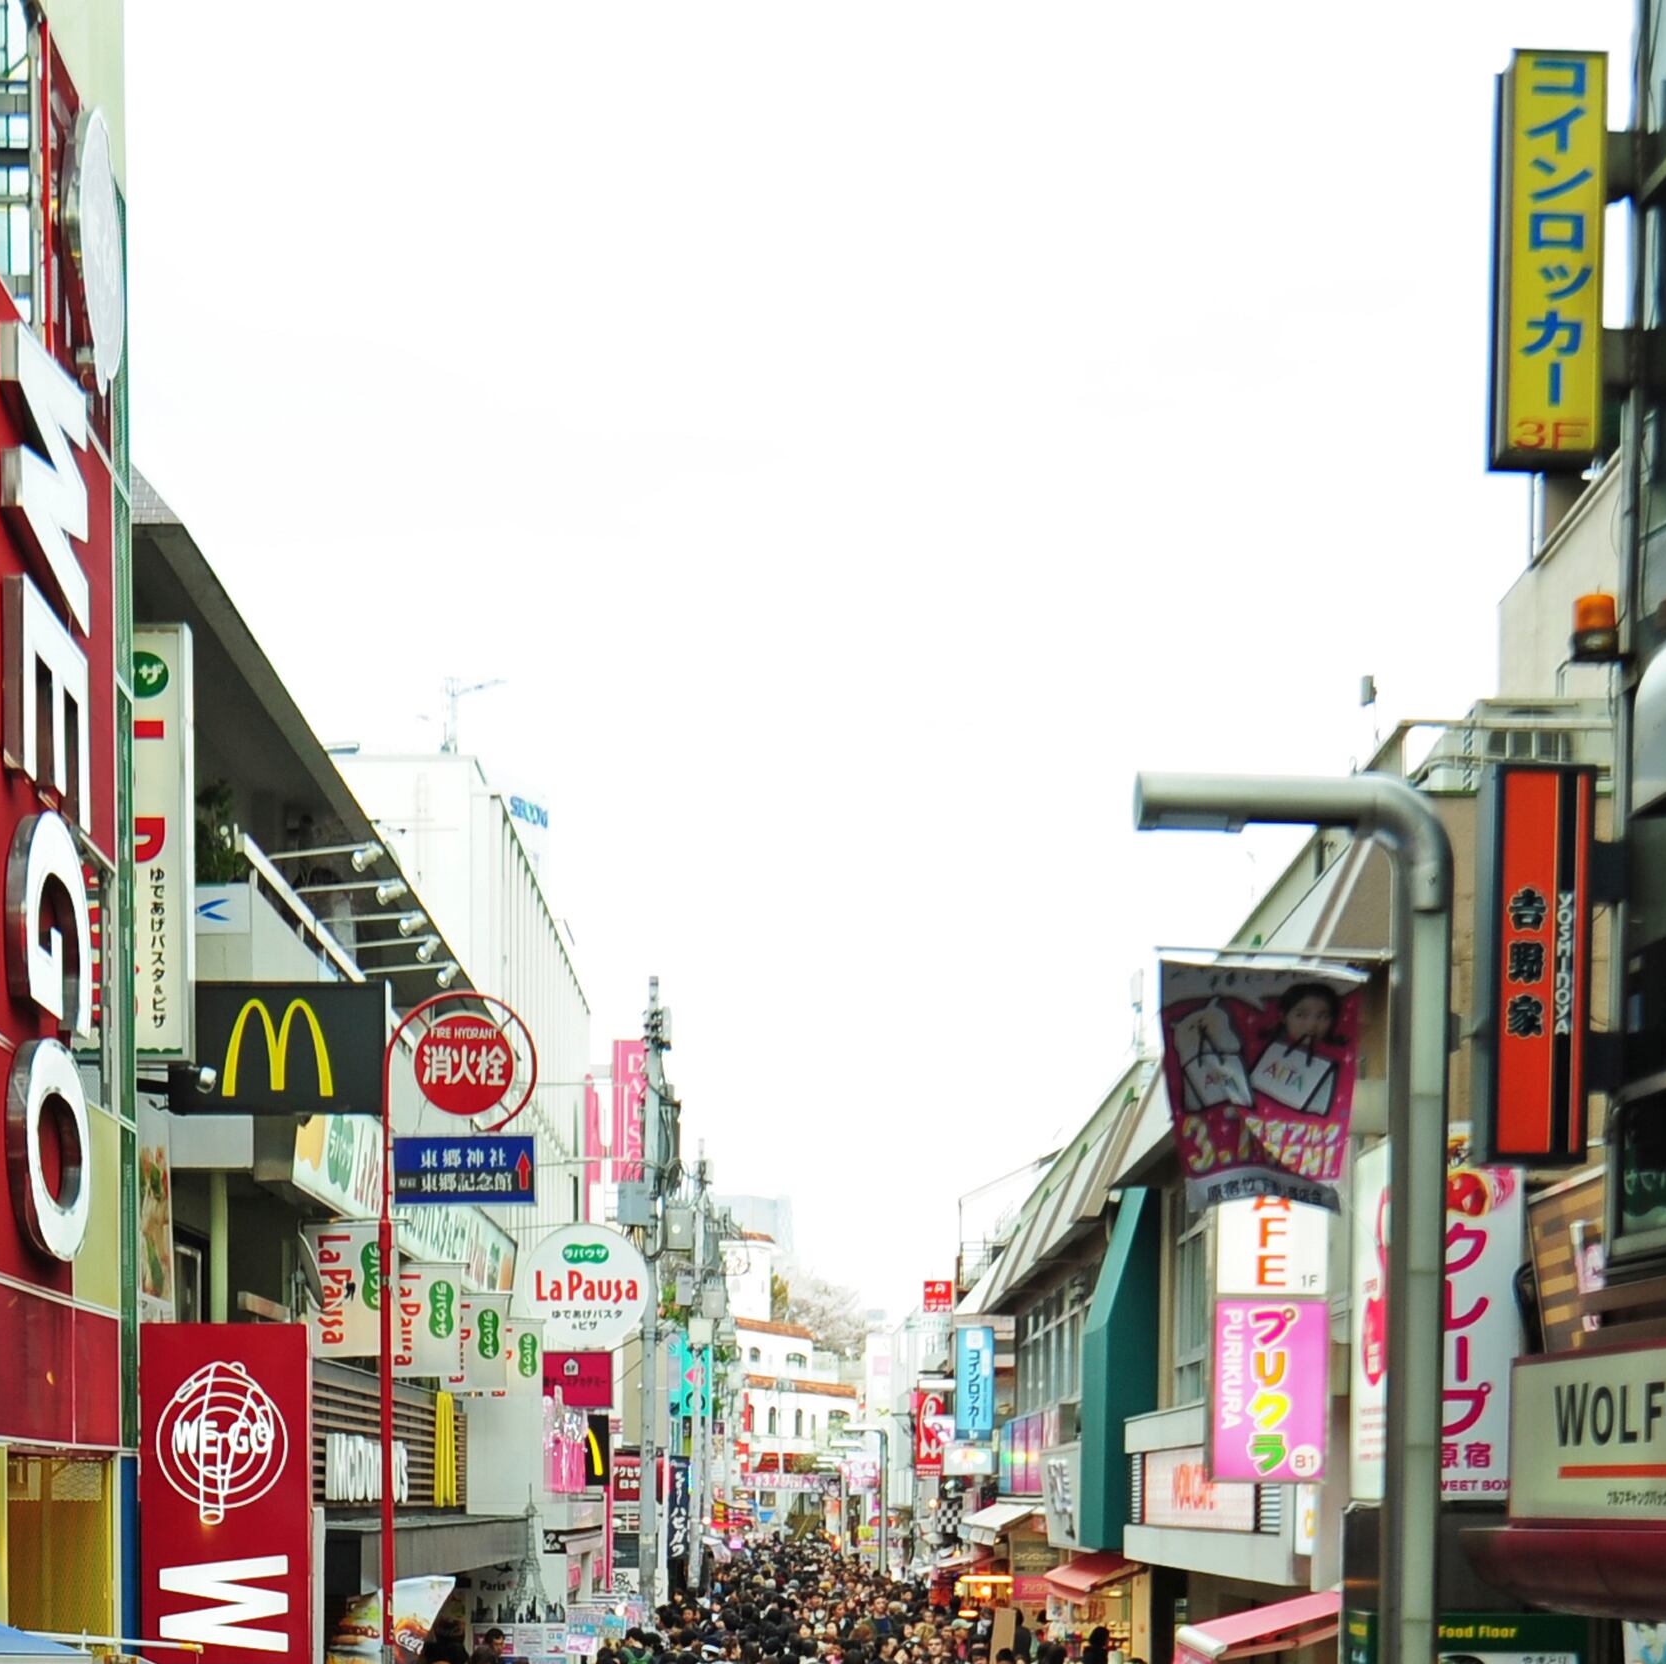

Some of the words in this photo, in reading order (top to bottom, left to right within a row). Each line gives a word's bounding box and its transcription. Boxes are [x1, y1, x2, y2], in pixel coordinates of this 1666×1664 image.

[1521, 60, 1594, 407] コインロッカー
[1515, 421, 1589, 449] 3F
[1, 318, 91, 1263] WEGO
[430, 1026, 451, 1039] FIRE
[454, 1027, 498, 1040] HYDRANT
[422, 1045, 507, 1086] 消火栓
[420, 1147, 507, 1169] 東郷神社
[420, 1172, 512, 1193] 東郷記念館
[535, 1270, 562, 1301] La
[567, 1270, 638, 1304] Pausa
[1301, 1275, 1319, 1288] 1F
[1220, 1308, 1243, 1430] PURIKURA
[967, 1349, 981, 1428] コインロッカー
[1248, 1307, 1299, 1475] プリクラ
[1295, 1453, 1315, 1471] B1
[1441, 1442, 1491, 1469] 原宿
[479, 1580, 506, 1592] Paris
[1438, 1625, 1474, 1639] Food
[1478, 1625, 1518, 1639] Floor
